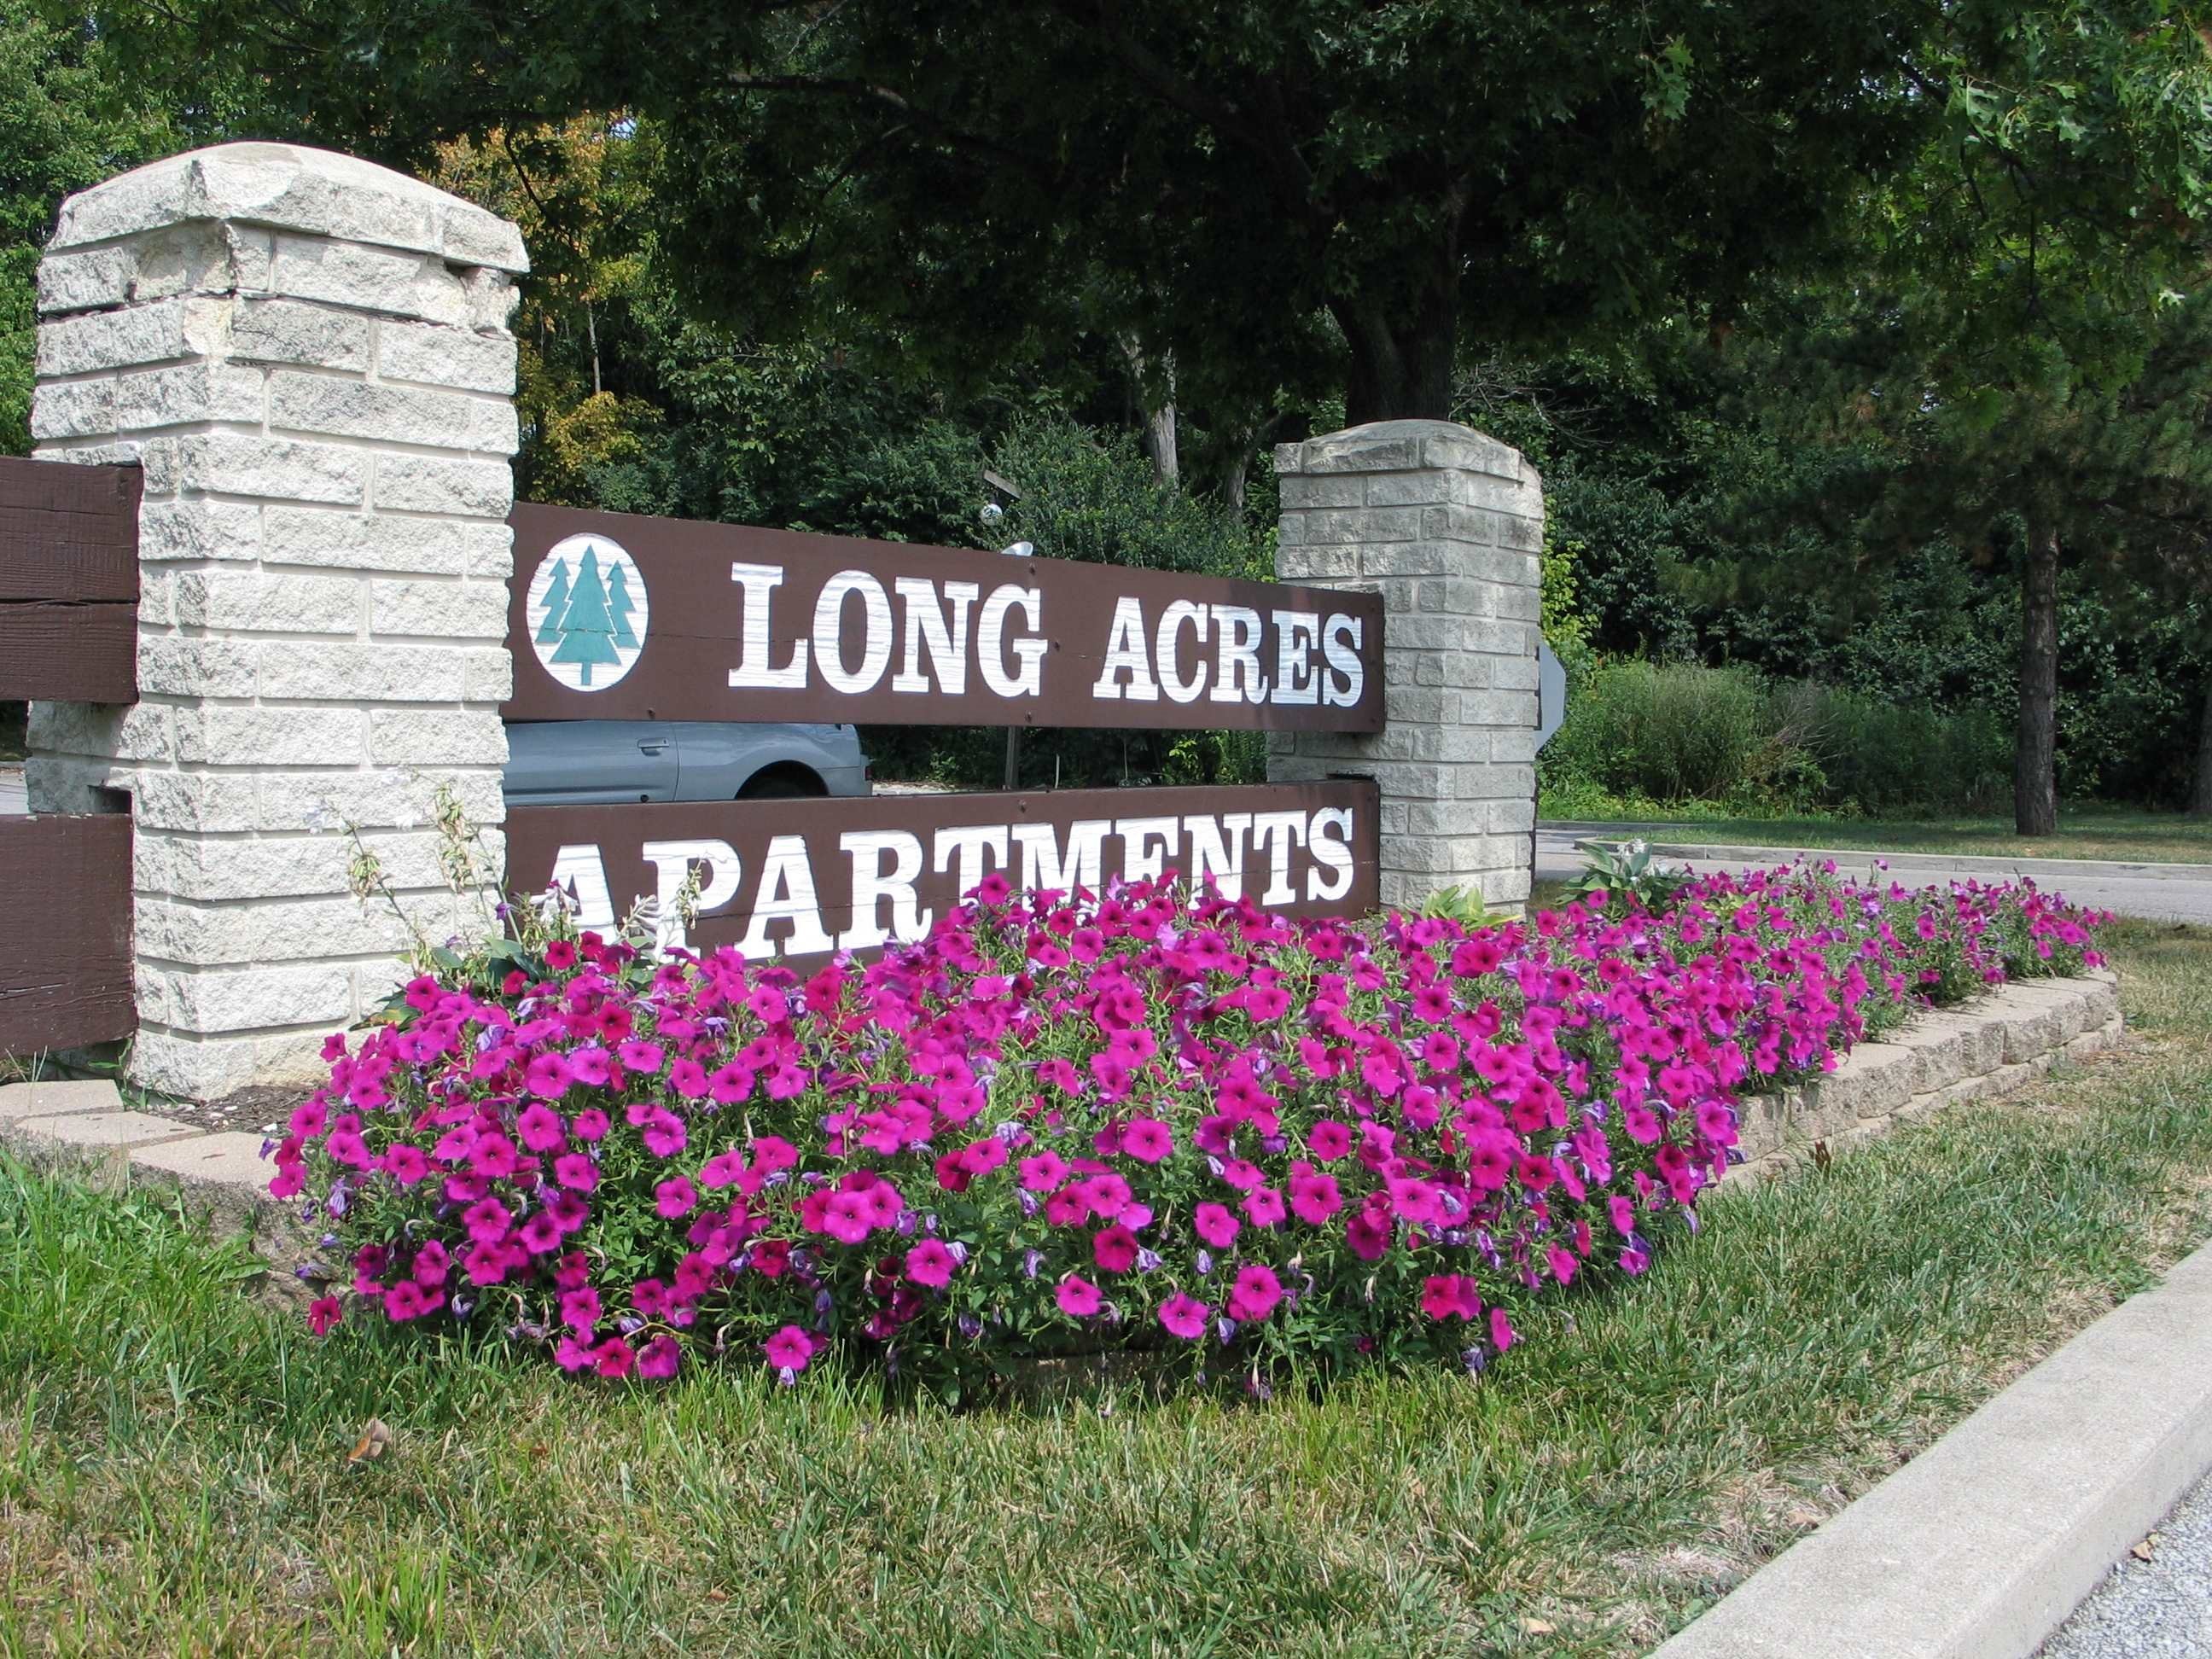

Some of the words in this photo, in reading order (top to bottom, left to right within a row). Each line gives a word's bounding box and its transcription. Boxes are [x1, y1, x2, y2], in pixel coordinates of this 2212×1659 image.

[729, 562, 1048, 697] LONG
[1092, 597, 1364, 707] ACRES
[544, 807, 1354, 962] APARTMENTS
